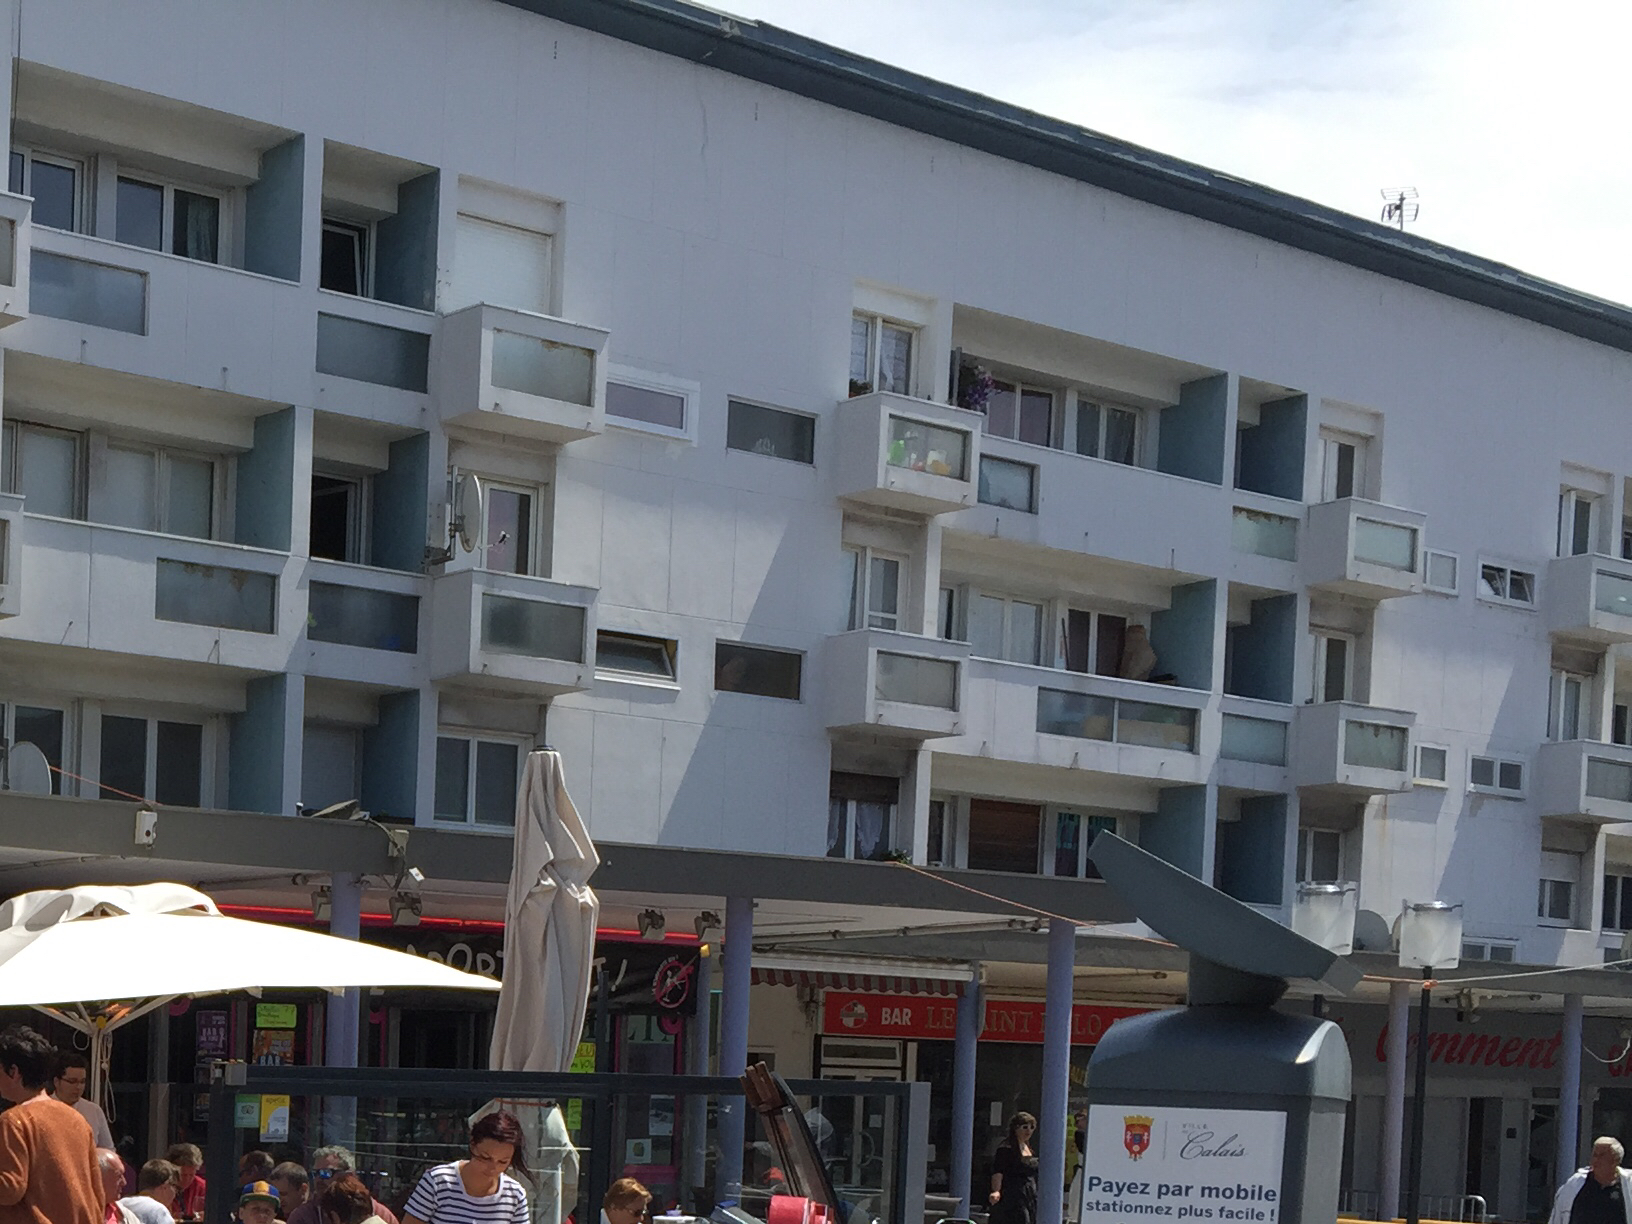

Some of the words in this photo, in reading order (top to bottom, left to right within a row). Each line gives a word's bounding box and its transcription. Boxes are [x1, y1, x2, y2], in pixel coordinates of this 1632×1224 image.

[881, 1007, 911, 1026] BAR
[925, 1006, 955, 1029] LE
[983, 1008, 1034, 1034] INT
[1376, 1022, 1563, 1069] Cmment
[1180, 1131, 1246, 1159] Calais
[1088, 1176, 1150, 1198] Payez
[1157, 1184, 1193, 1199] par
[1201, 1183, 1277, 1201] mobile
[1086, 1200, 1172, 1215] stationnez
[1178, 1204, 1213, 1219] plus
[1219, 1206, 1265, 1221] facile
[1270, 1208, 1275, 1221] !
